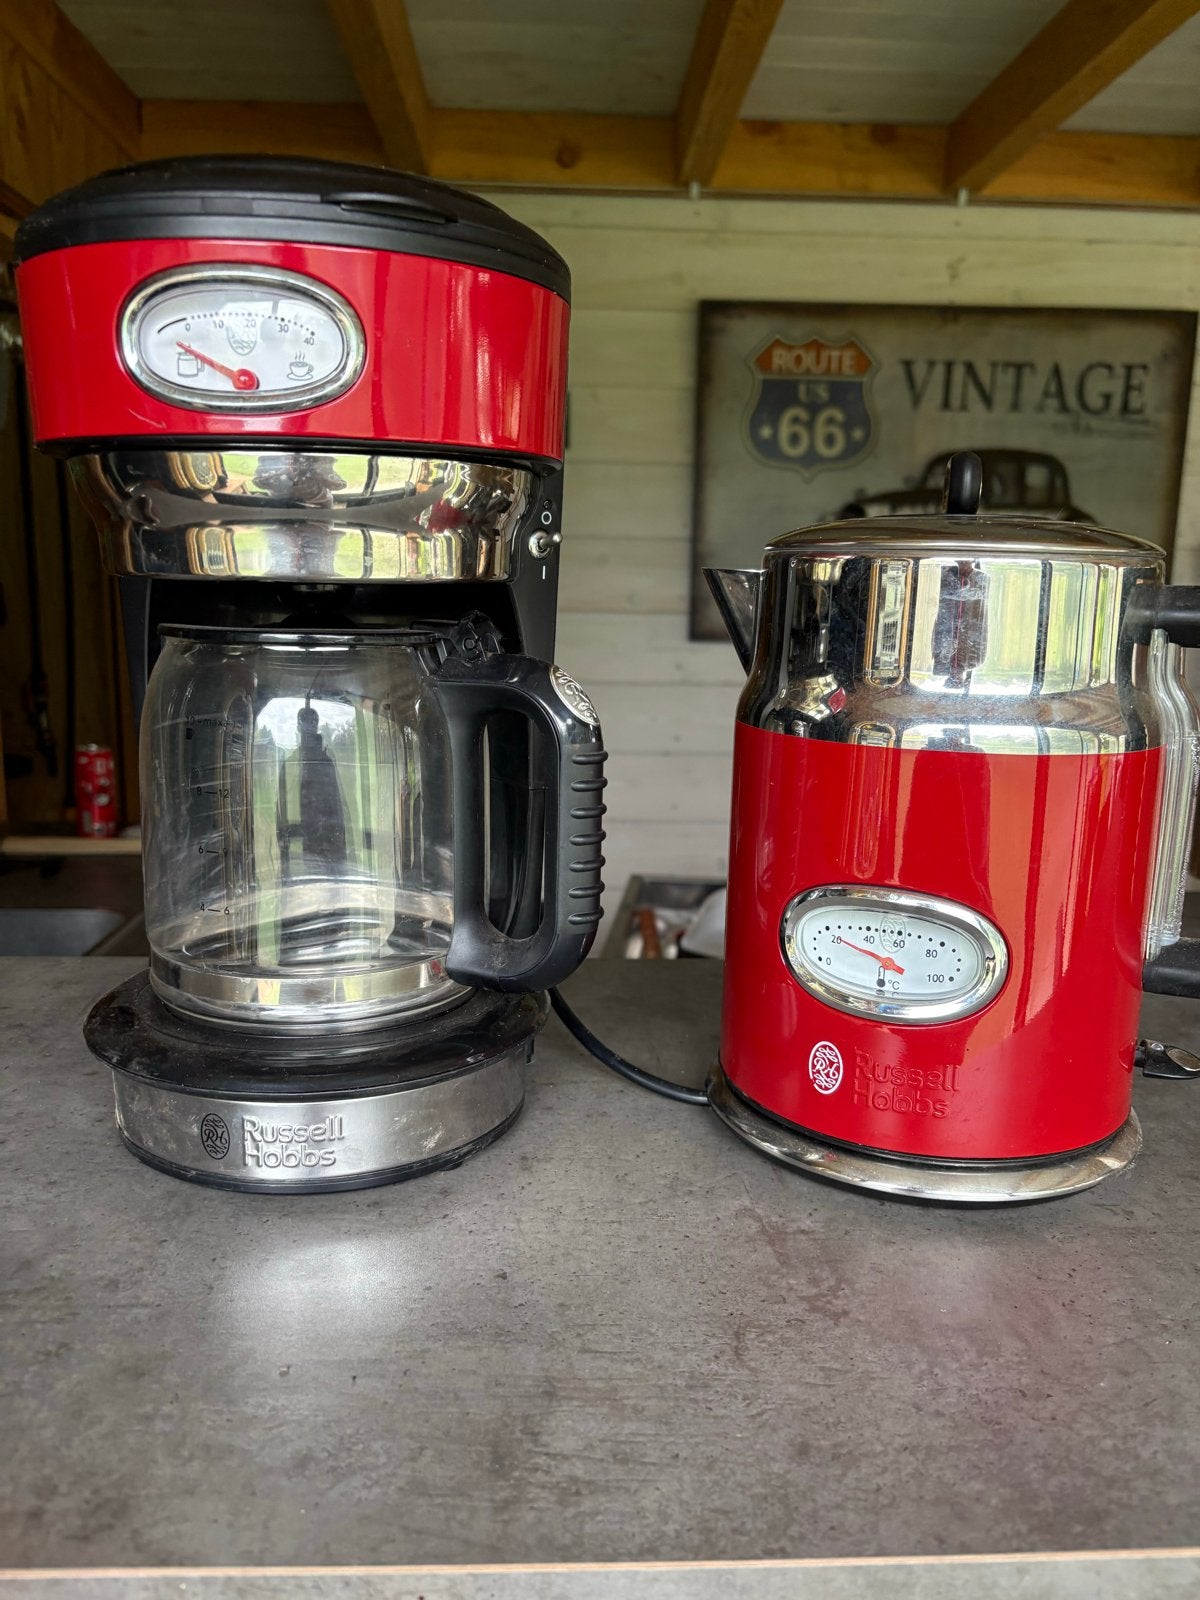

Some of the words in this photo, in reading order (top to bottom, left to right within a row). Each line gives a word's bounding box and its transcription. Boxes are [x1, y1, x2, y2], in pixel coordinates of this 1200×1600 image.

[185, 322, 191, 332] 0
[212, 320, 224, 329] 10
[245, 319, 257, 328] 20
[278, 323, 289, 333] 30
[303, 336, 315, 346] 40
[771, 348, 857, 375] ROUTE
[798, 382, 831, 403] US
[898, 359, 1149, 417] VINTAGE
[778, 405, 847, 458] 66
[831, 934, 842, 944] 20
[863, 935, 875, 944] 40
[893, 939, 906, 949] 60
[925, 949, 938, 959] 80
[825, 957, 832, 966] 0
[927, 973, 945, 983] 100
[854, 1047, 960, 1092] Russell
[853, 1078, 950, 1119] Hobbs
[242, 1114, 346, 1143] Russell
[243, 1142, 337, 1168] Hobbs
